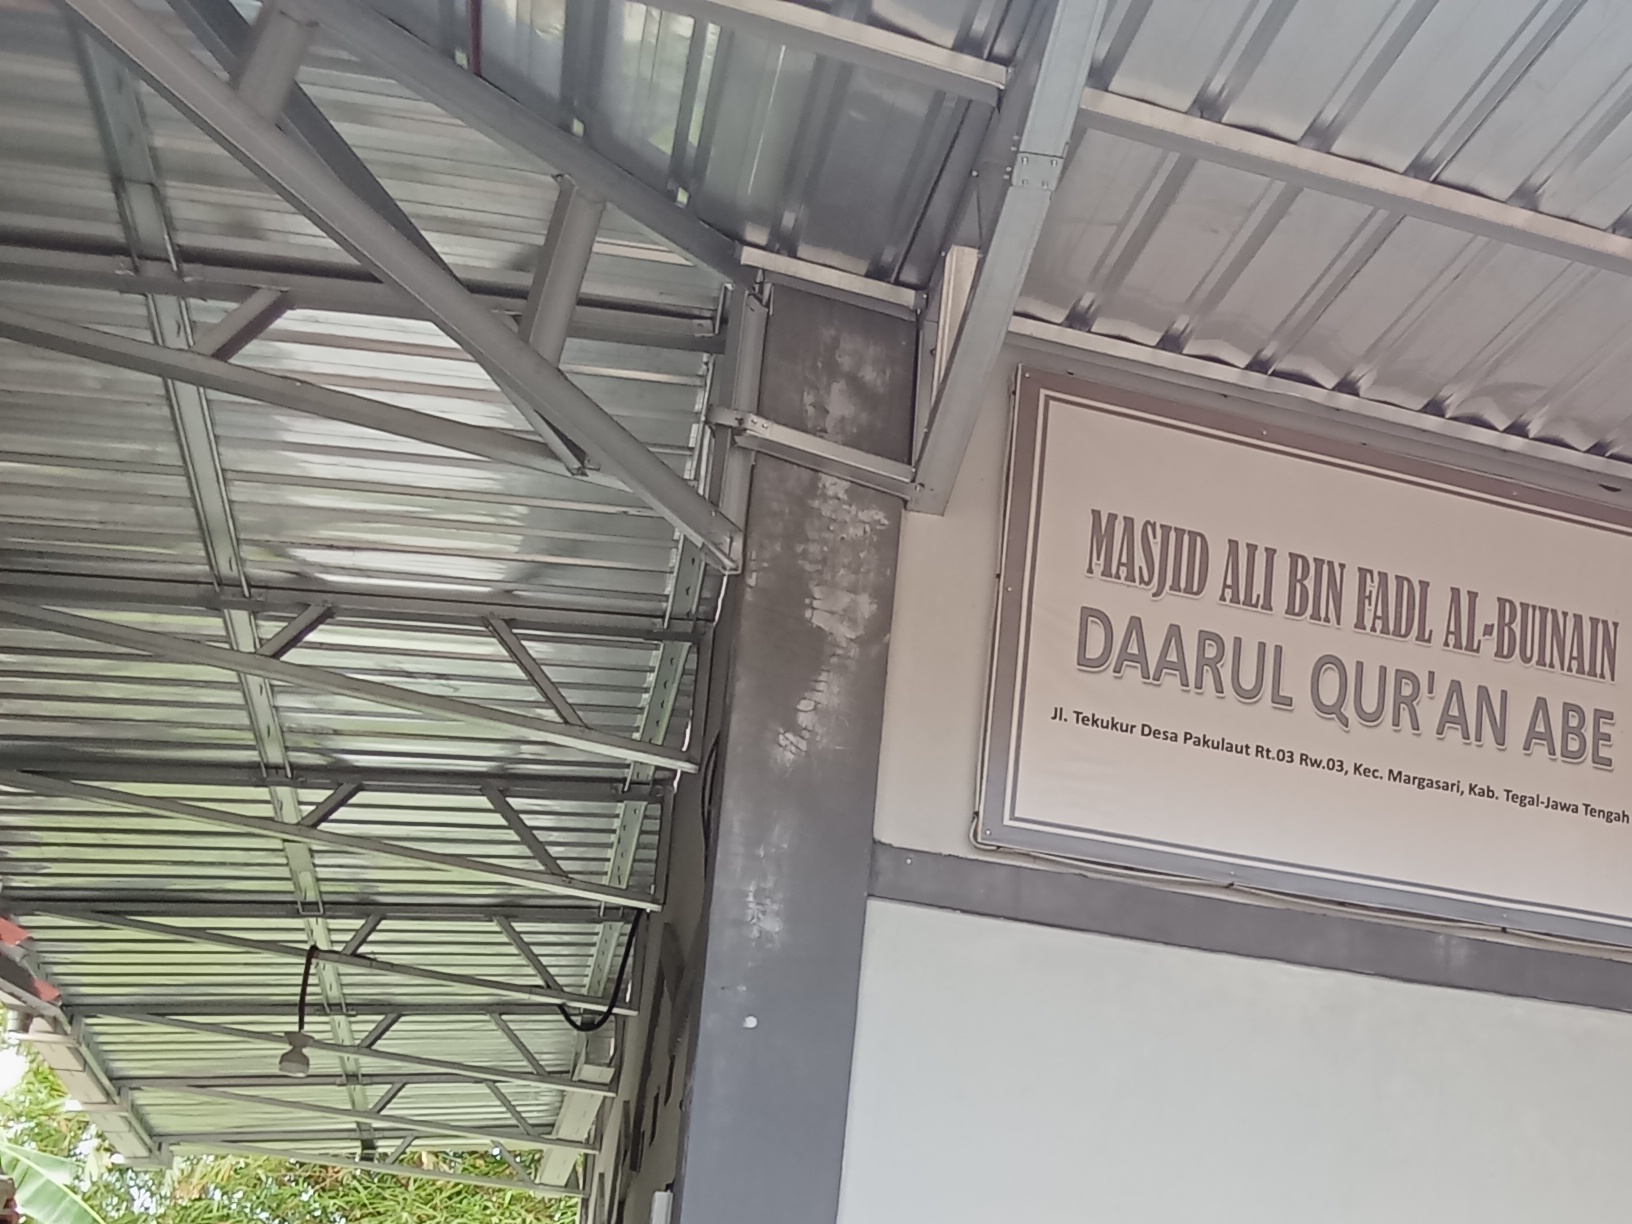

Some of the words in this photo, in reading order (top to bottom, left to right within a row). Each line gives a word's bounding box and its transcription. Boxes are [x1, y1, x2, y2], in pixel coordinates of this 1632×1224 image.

[1086, 508, 1210, 598] MASJID
[1219, 538, 1278, 613] ALI
[1284, 551, 1346, 627] BIN
[1353, 566, 1433, 645] FADL
[1442, 586, 1620, 683] AL-BUINAIN
[1050, 706, 1069, 723] Jl.
[1073, 710, 1137, 736] Tekukur
[1140, 723, 1179, 743] Desa
[1183, 732, 1251, 757] Pakulaut
[1255, 744, 1295, 765] Rt.03
[1299, 753, 1350, 777] Rw.03,
[1352, 762, 1384, 781] Kec.
[1387, 768, 1466, 797] Margasari,
[1468, 783, 1500, 800] Kab.
[1503, 788, 1580, 816] Tegal-Jawa
[1582, 802, 1631, 825] Tengah
[1076, 606, 1294, 708] DAARUL
[1311, 654, 1509, 748] QUR'AN
[1522, 696, 1616, 768] ABE
